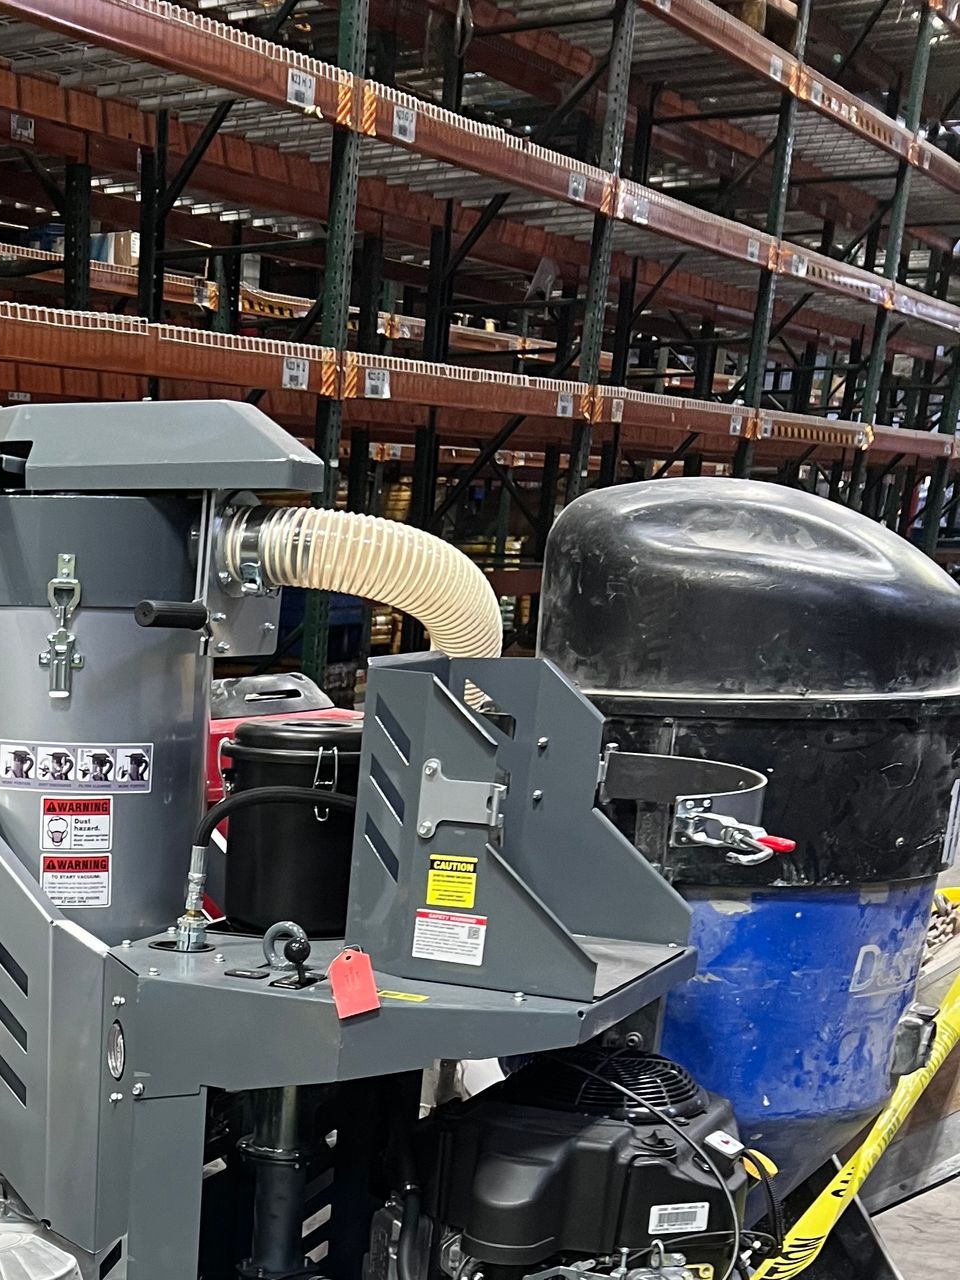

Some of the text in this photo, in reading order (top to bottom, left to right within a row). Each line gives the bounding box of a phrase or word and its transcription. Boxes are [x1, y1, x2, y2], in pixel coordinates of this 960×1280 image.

[57, 801, 109, 813] WARNING
[56, 859, 107, 870] WARNING
[433, 861, 474, 872] CAUTION
